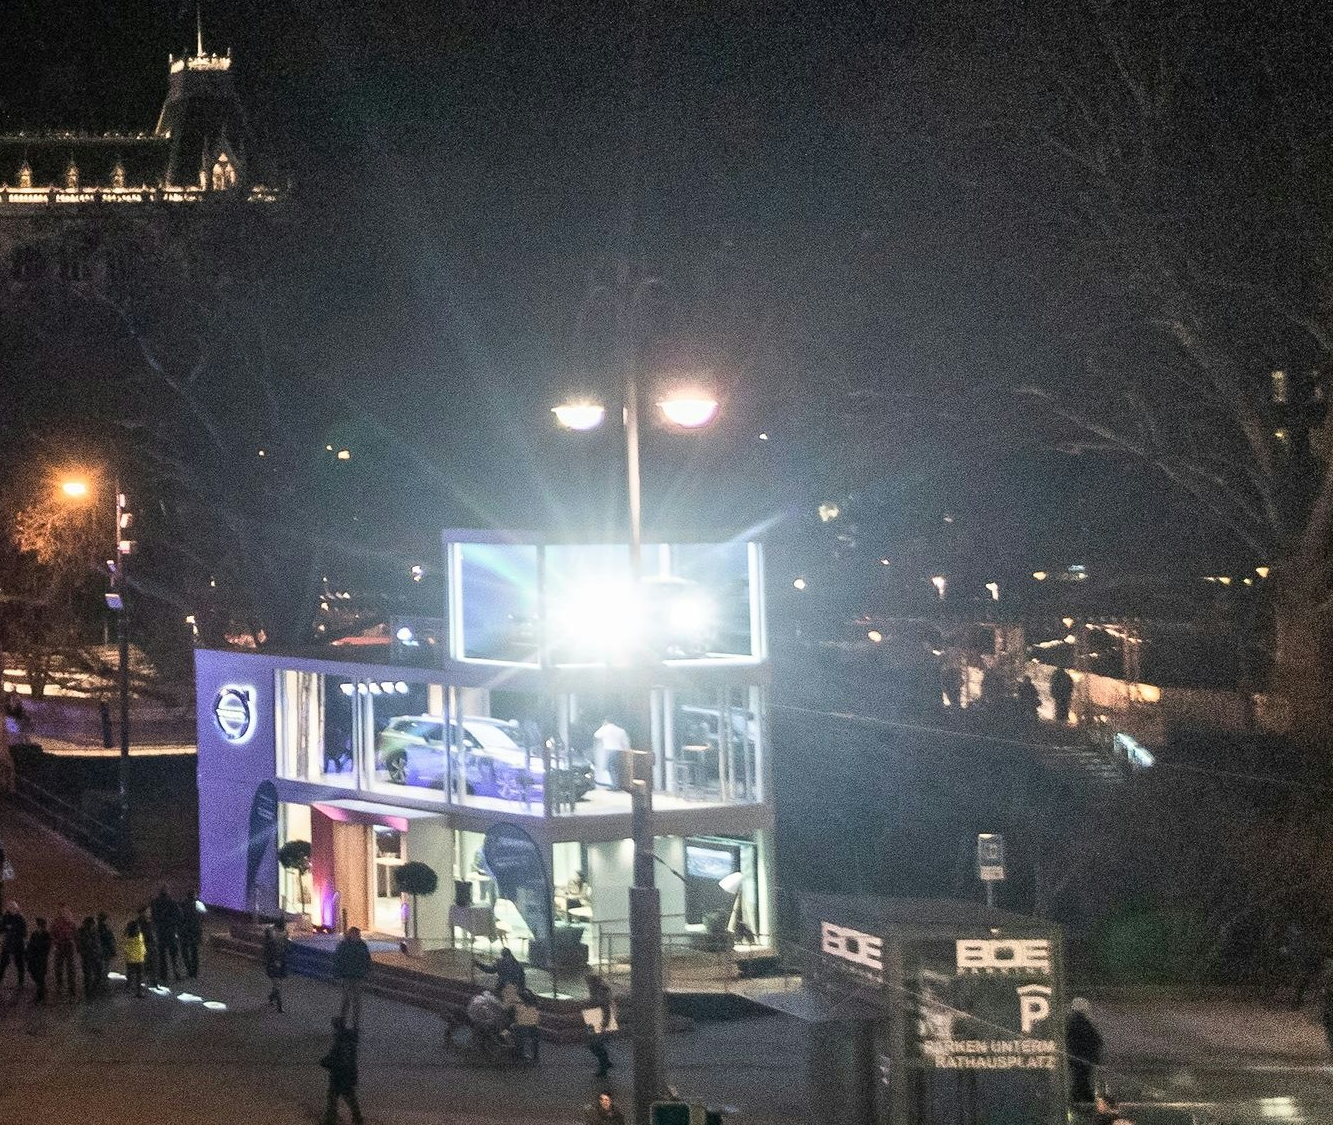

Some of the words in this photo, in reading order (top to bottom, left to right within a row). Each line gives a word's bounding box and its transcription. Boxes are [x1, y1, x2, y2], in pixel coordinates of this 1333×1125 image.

[821, 920, 883, 971] BOE
[956, 938, 1050, 968] BOE
[1019, 995, 1050, 1033] P
[991, 1039, 1055, 1054] UNTERM
[935, 1055, 1055, 1069] RATHAUSPLATZ
